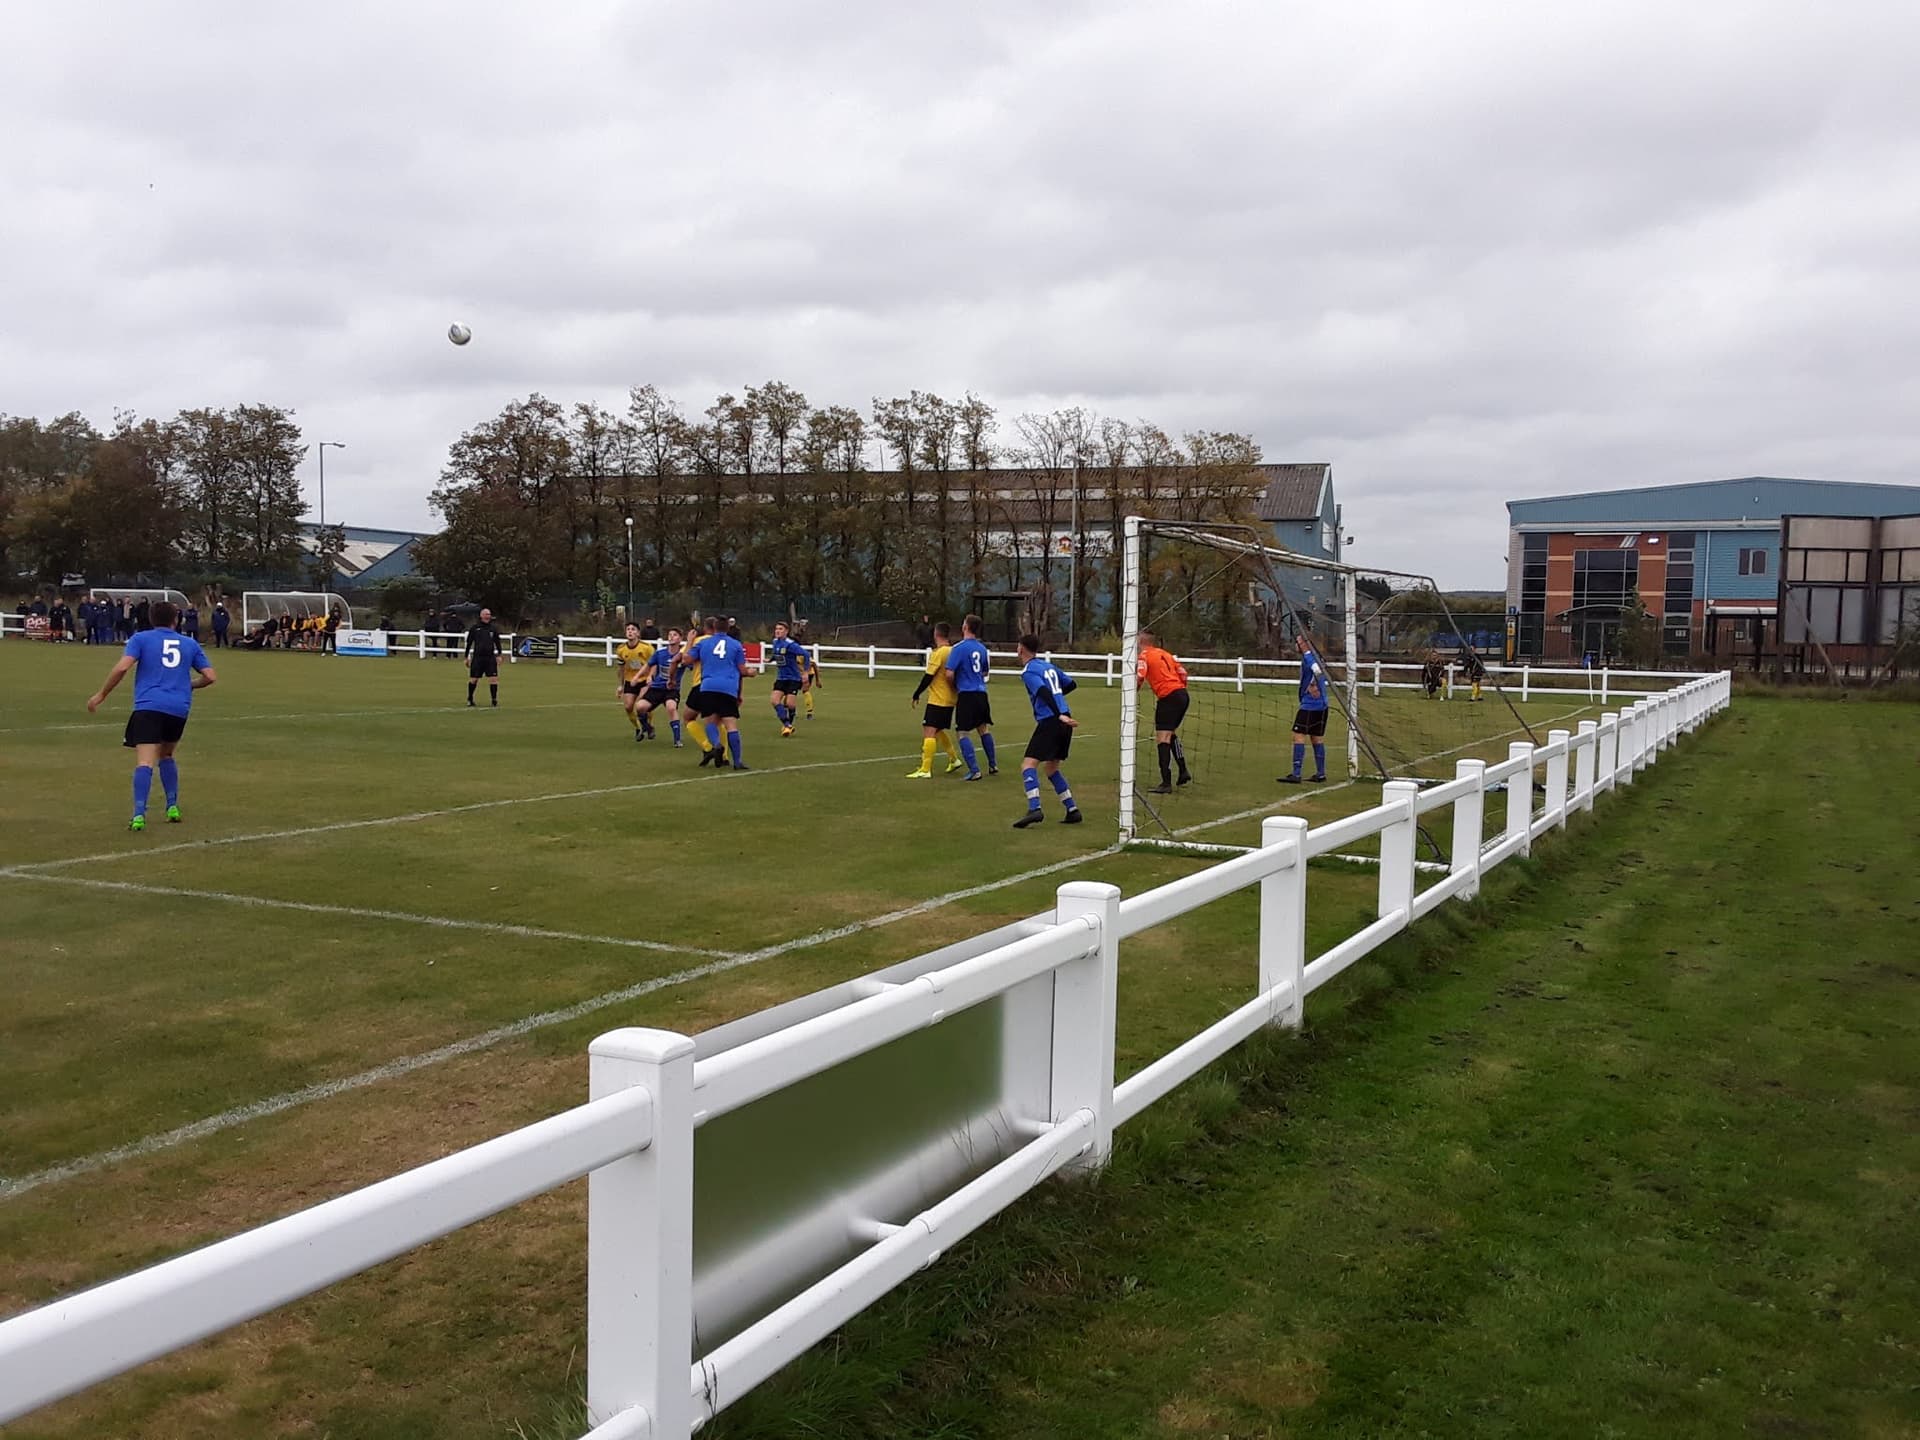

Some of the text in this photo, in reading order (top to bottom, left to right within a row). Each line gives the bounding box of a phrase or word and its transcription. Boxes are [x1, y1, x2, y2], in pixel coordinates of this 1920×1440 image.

[162, 639, 181, 668] 5
[713, 639, 726, 659] 4
[972, 651, 981, 673] 3
[1044, 668, 1063, 694] 12
